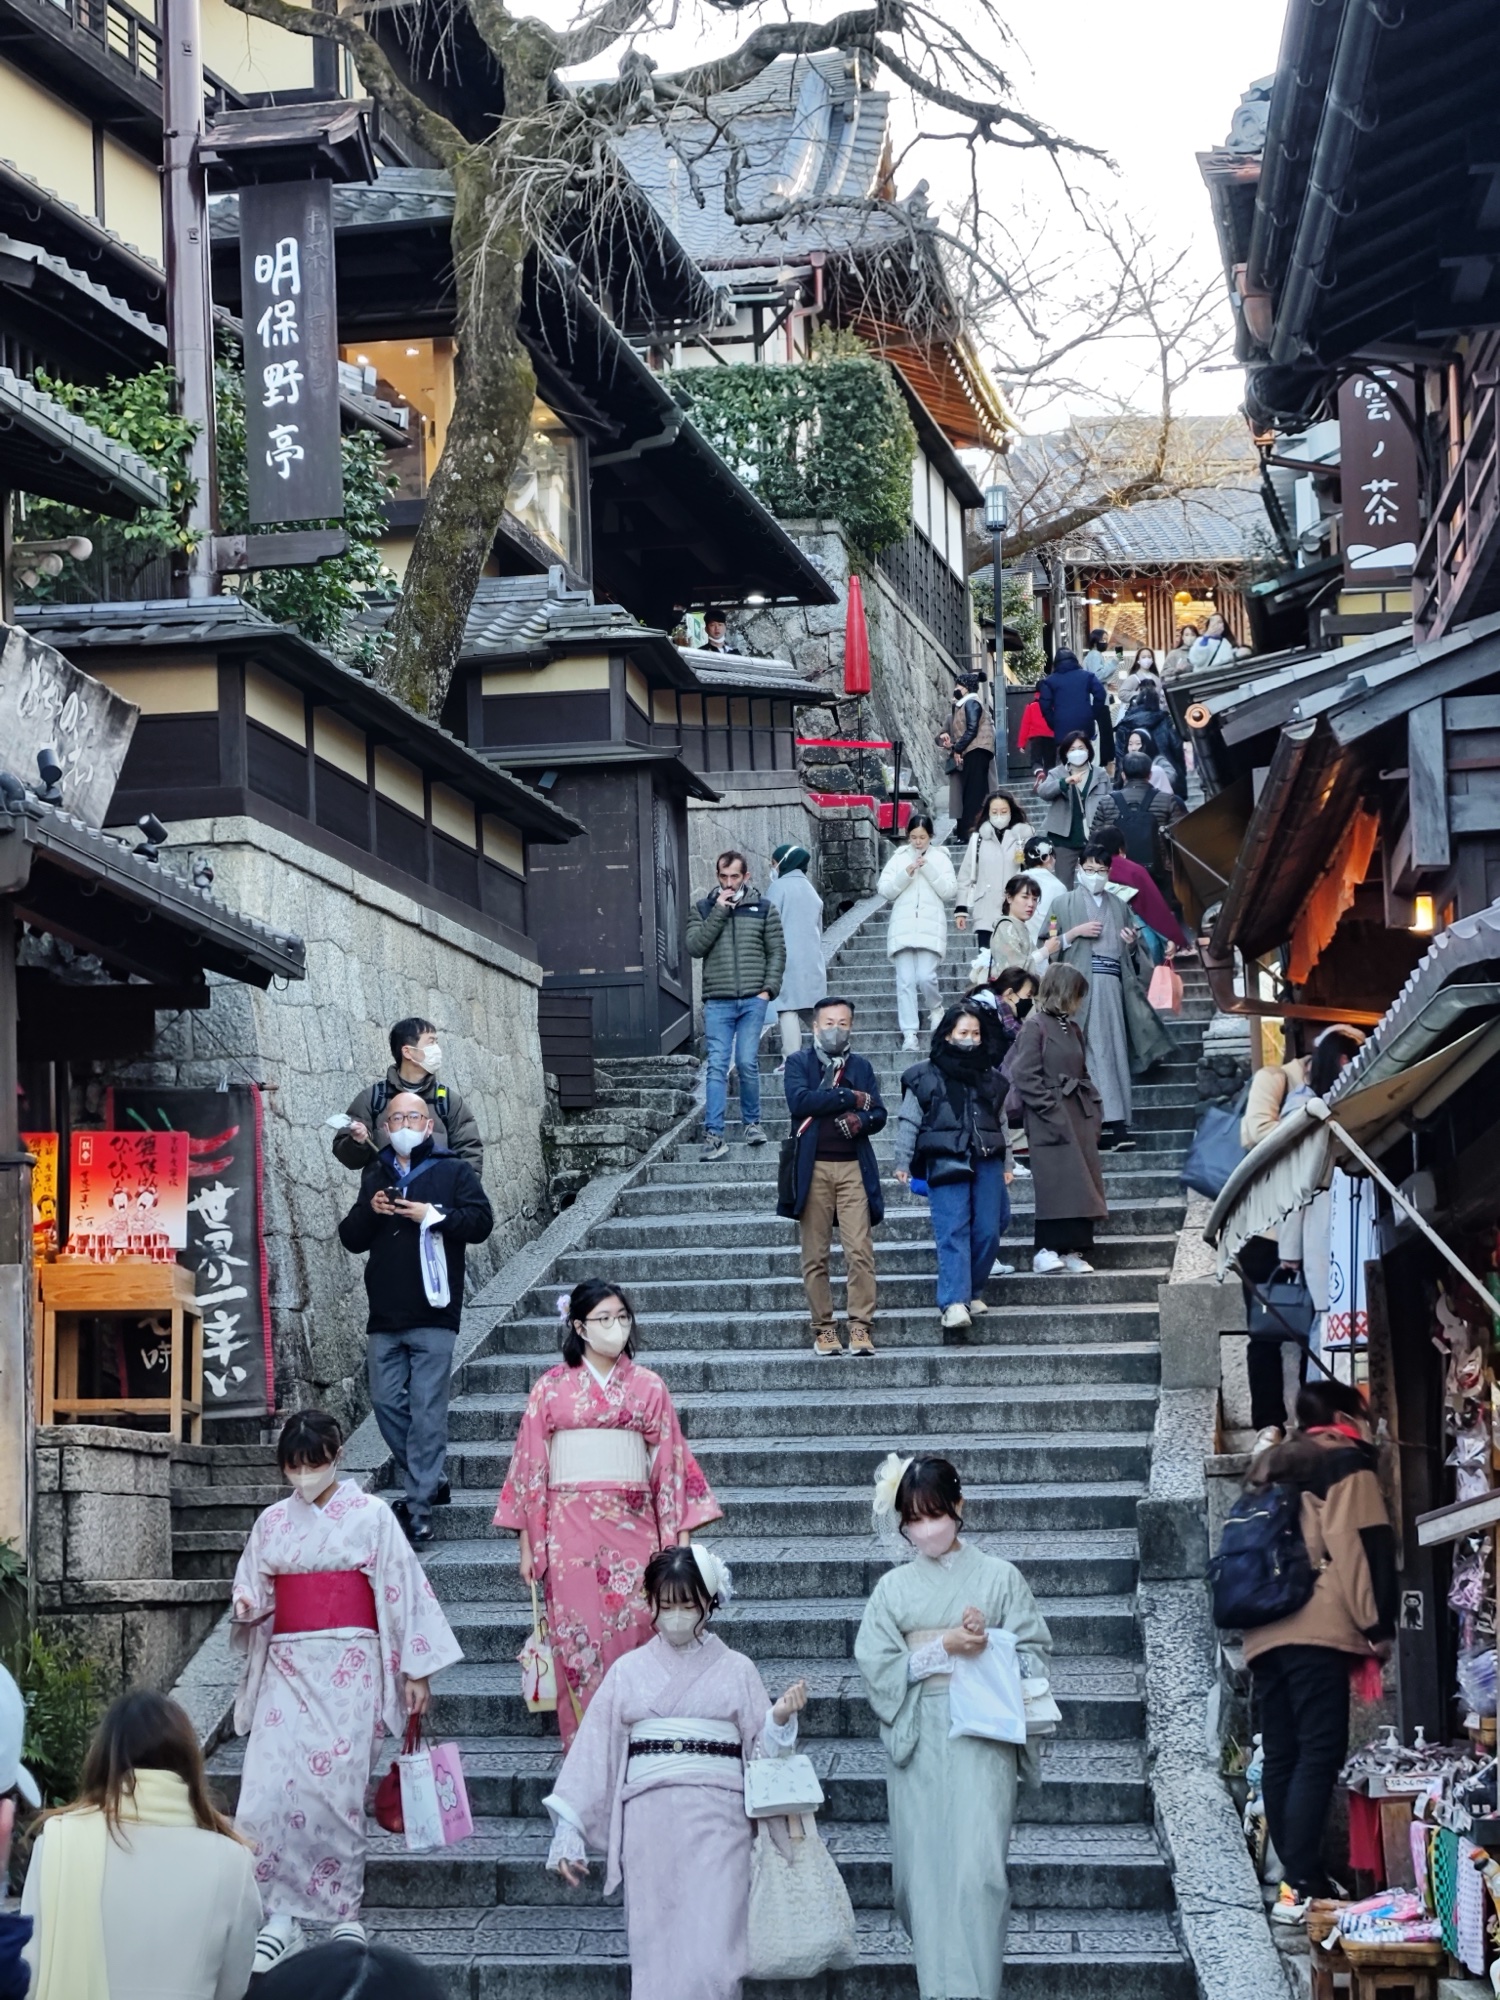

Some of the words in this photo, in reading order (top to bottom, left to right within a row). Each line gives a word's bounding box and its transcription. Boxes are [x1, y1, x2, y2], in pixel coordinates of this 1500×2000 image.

[254, 236, 304, 480] 明保野亭
[187, 1180, 251, 1397] 世界一辛い
